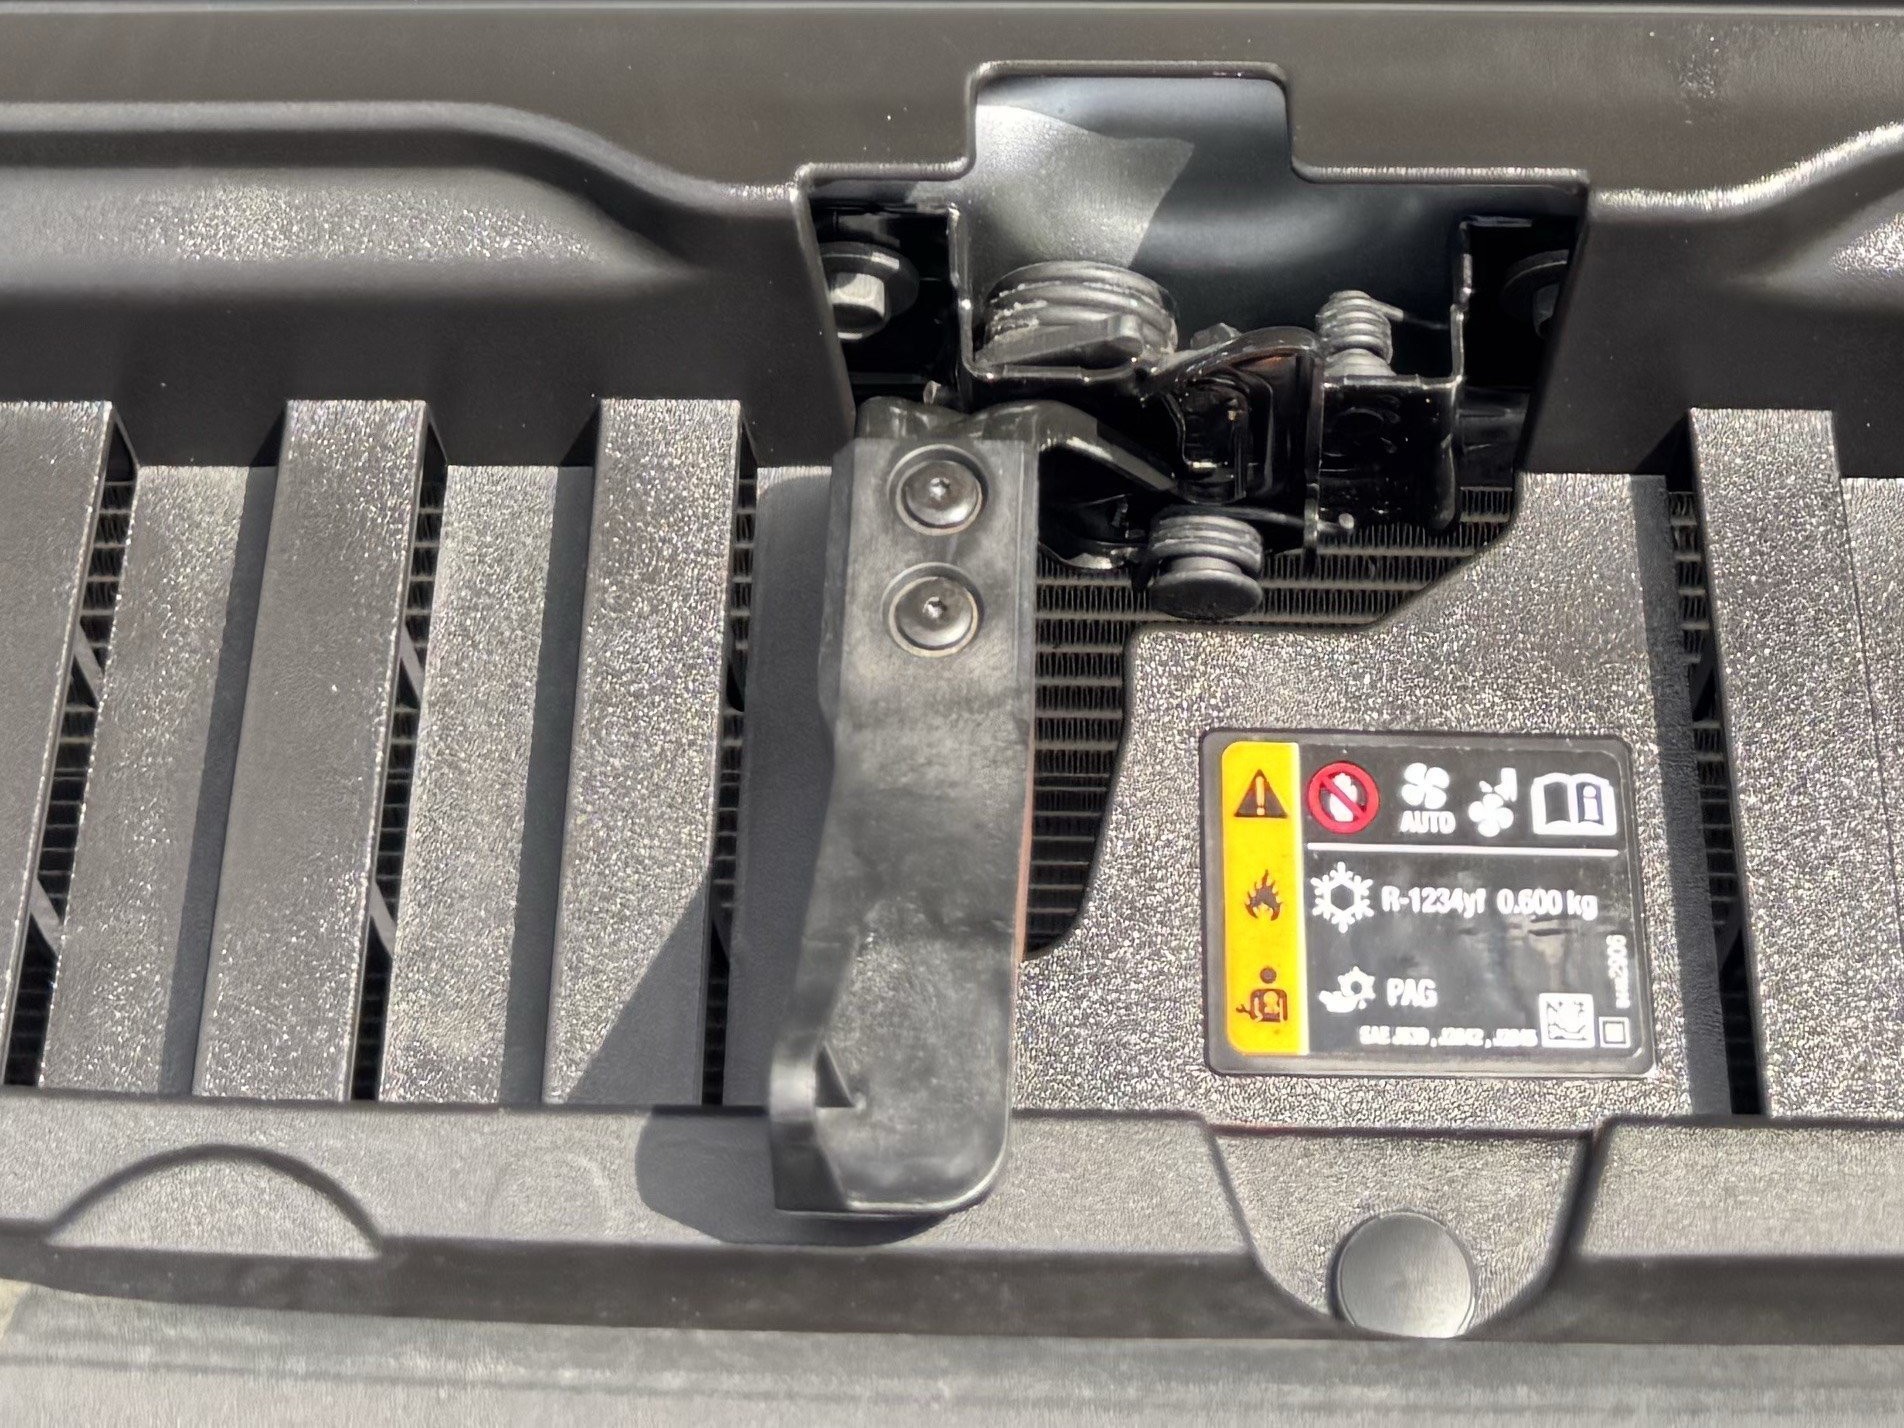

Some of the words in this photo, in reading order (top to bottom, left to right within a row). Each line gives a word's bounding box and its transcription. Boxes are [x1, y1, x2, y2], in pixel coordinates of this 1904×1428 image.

[1399, 810, 1456, 834] AUTO
[1381, 885, 1487, 919] R-1234yf
[1566, 889, 1600, 921] kg
[1386, 977, 1438, 1008] PAG
